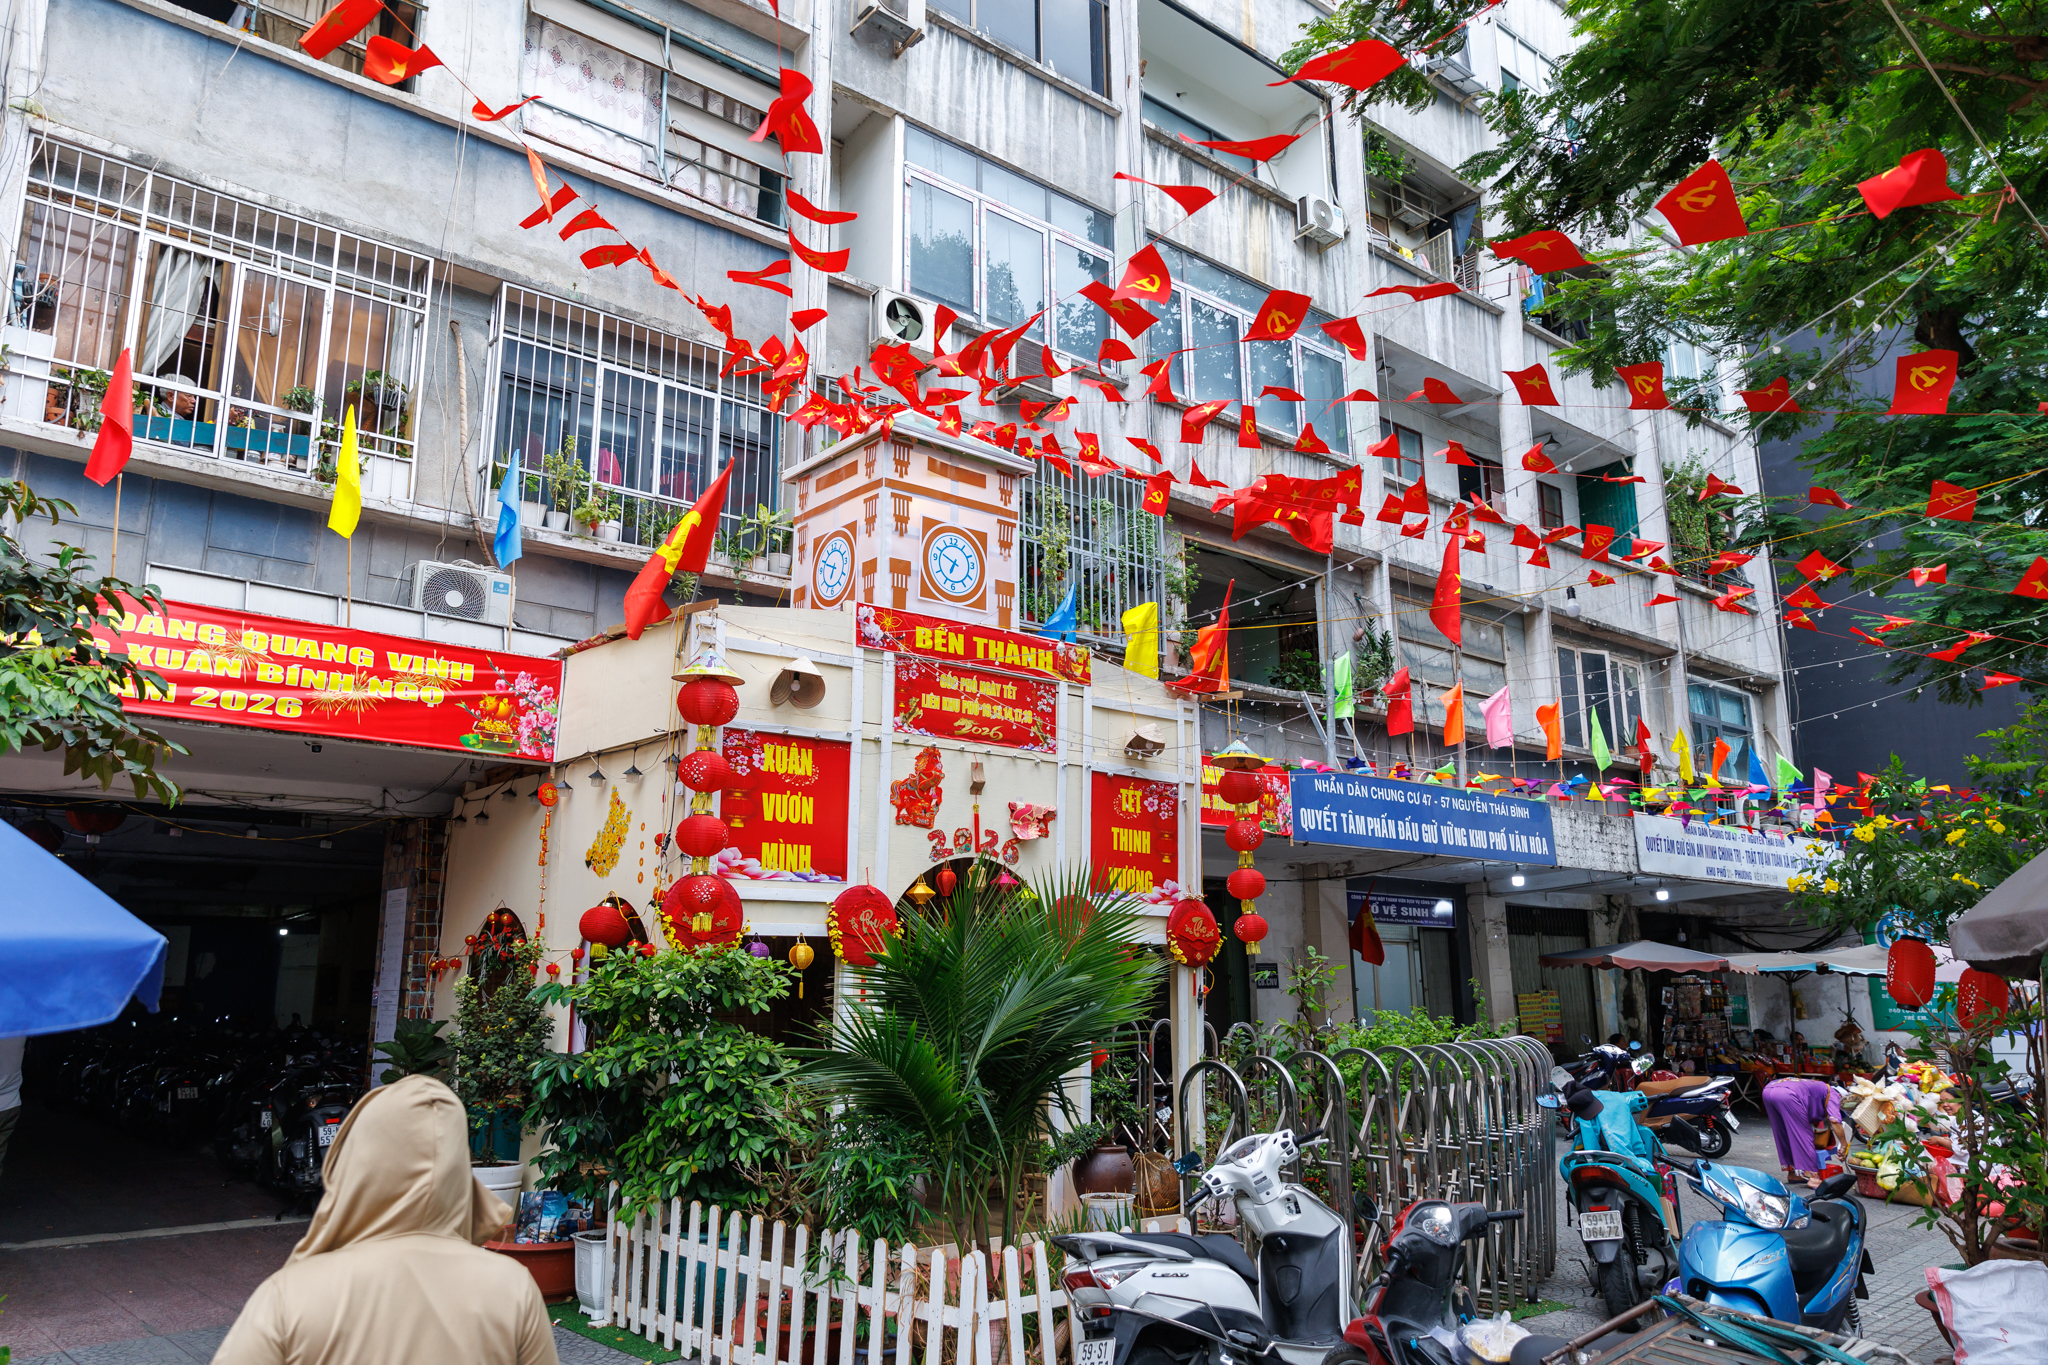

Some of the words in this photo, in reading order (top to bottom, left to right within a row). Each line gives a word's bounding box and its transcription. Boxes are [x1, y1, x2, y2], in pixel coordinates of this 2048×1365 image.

[949, 537, 958, 546] 12
[970, 562, 975, 570] 3
[950, 583, 956, 591] 6
[241, 629, 375, 668] QUANG
[386, 651, 475, 682] VINH
[915, 623, 964, 656] BẾN
[973, 636, 1054, 672] THÀNH
[126, 643, 243, 679] XUÂN
[256, 662, 355, 694] BÍNH
[367, 678, 445, 708] NGỌ
[979, 679, 1001, 697] NGÀY
[1003, 682, 1017, 700] TẾT
[190, 686, 303, 718] 2026
[922, 692, 940, 710] LIÊN
[942, 696, 960, 713] KHU
[763, 742, 812, 777] XUÂN
[762, 790, 814, 825] VƯƠN
[1120, 782, 1142, 814] TẾT
[1347, 781, 1368, 798] DÂN
[1370, 786, 1405, 803] CHUNG
[1407, 791, 1421, 805] CƯ
[1421, 794, 1431, 806] 47
[1440, 796, 1450, 808] 57
[1452, 793, 1488, 814] NGUYỄN
[1489, 801, 1508, 816] THÁI
[1510, 803, 1529, 819] BÌNH
[1111, 826, 1151, 857] THỊNH
[1300, 804, 1338, 832] QUYẾT
[1341, 810, 1366, 836] TÂM
[1367, 813, 1396, 839] PHẤN
[1398, 815, 1419, 842] ĐẤU
[1440, 821, 1467, 847] VỮNG
[1469, 829, 1487, 849] KHU
[1489, 827, 1507, 851] PHỐ
[1509, 832, 1528, 853] VĂN
[1529, 832, 1549, 855] HÓA
[1709, 829, 1724, 839] CHUNG
[761, 838, 811, 873] MÌNH
[1645, 833, 1663, 853] QUYẾT
[1697, 844, 1704, 858] AN
[1705, 844, 1717, 860] NINH
[1718, 845, 1734, 861] CHÍNH
[1764, 853, 1771, 866] AN
[1108, 865, 1153, 896] VƯỢNG
[1706, 866, 1716, 876] KHU
[1717, 866, 1726, 878] PHỐ
[1382, 904, 1397, 917] VỆ
[1401, 907, 1429, 917] SINH
[1586, 1214, 1615, 1226] 59-TA
[1717, 1226, 1740, 1234] HONDA
[1082, 1341, 1107, 1360] 59-S1
